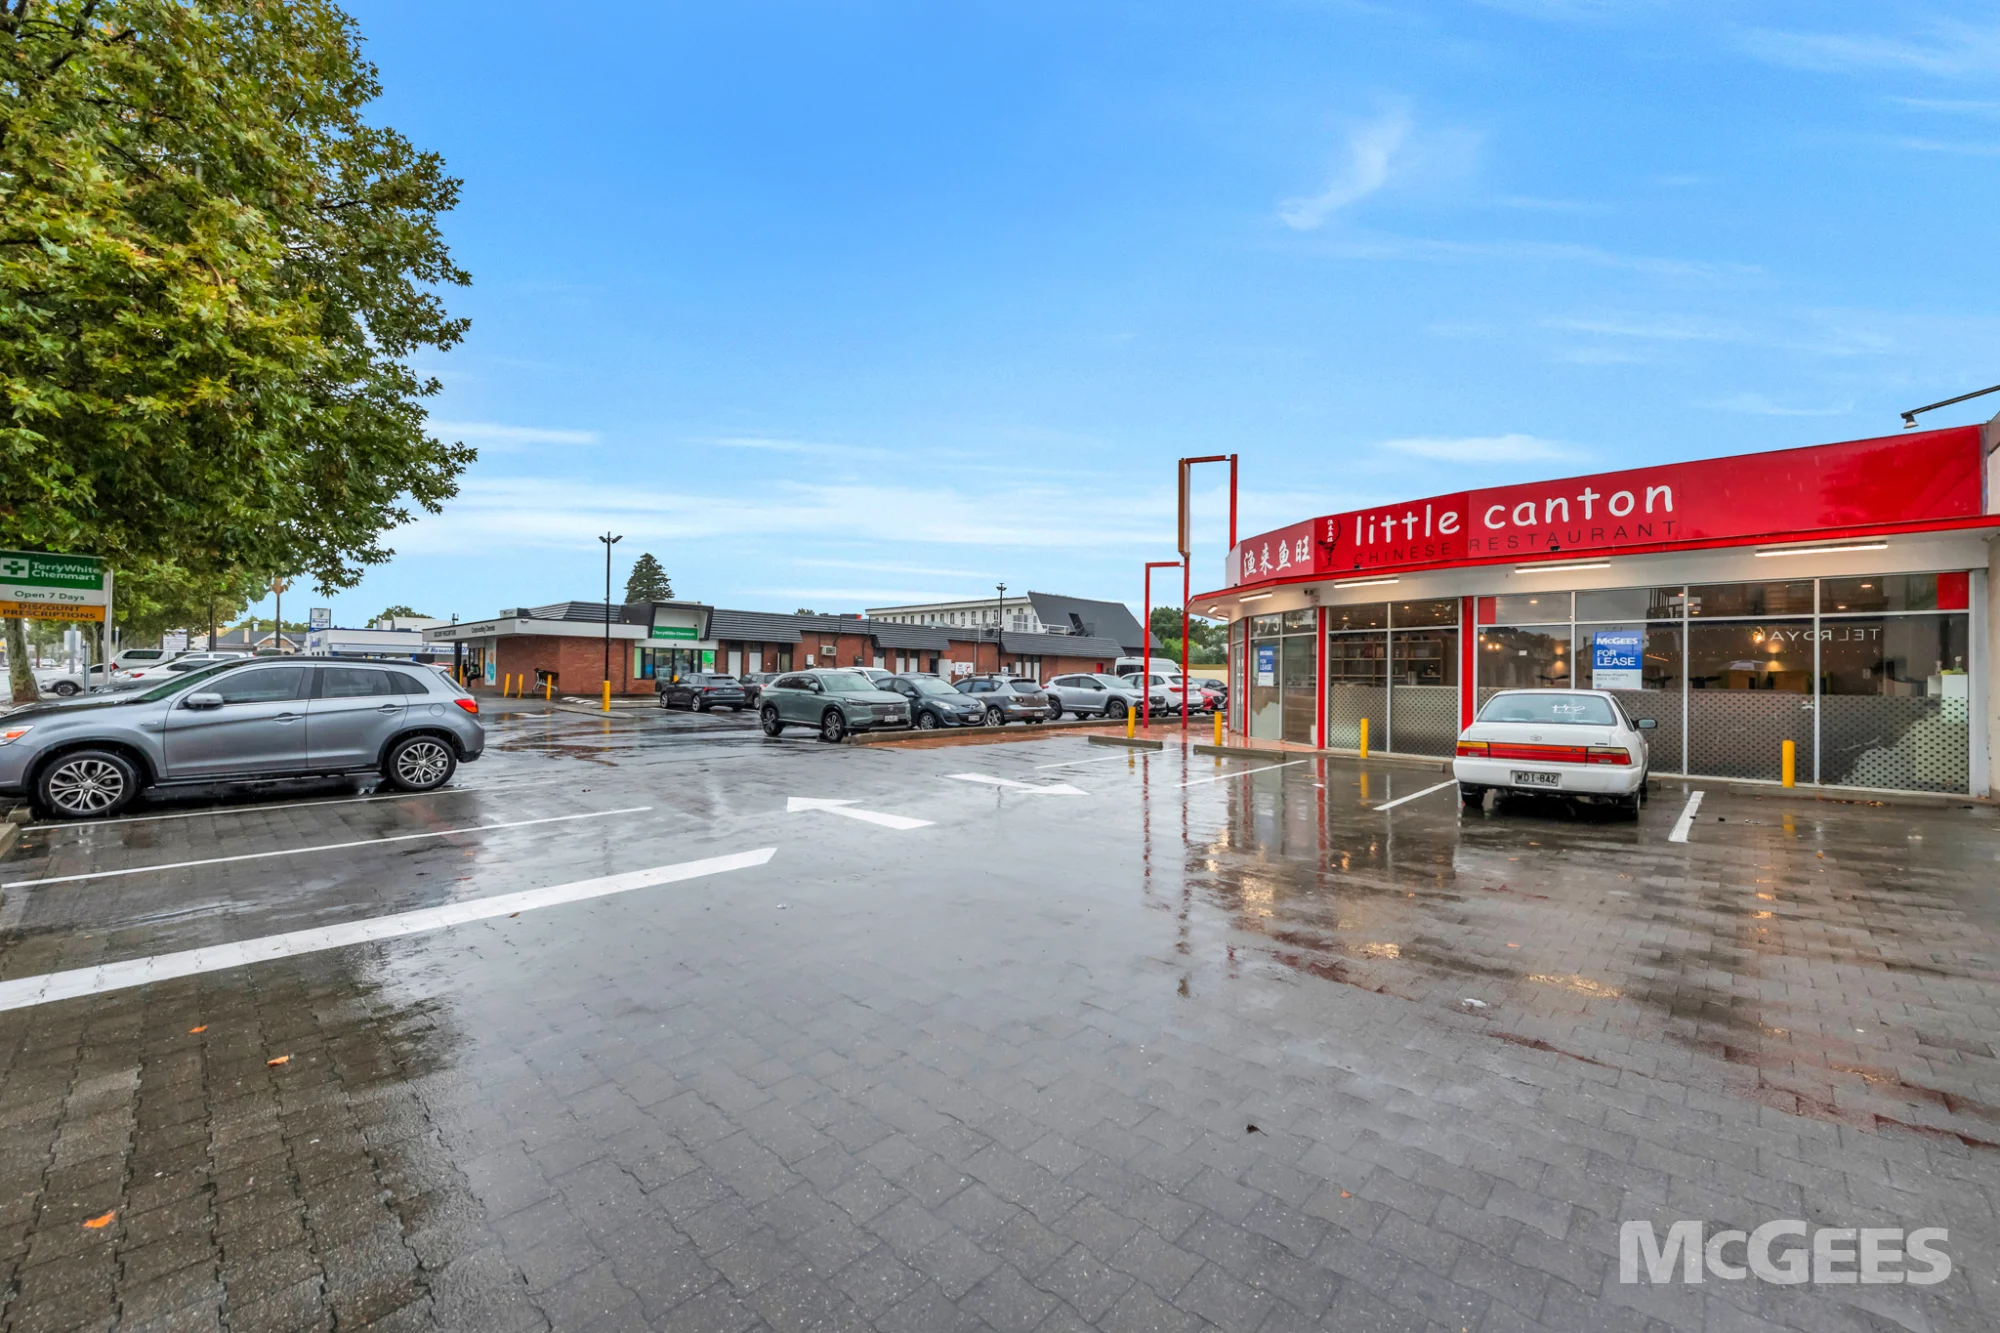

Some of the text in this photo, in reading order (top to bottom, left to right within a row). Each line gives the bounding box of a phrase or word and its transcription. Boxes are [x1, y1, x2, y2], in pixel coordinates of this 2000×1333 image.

[1355, 485, 1673, 546] little canton
[1354, 520, 1677, 565] CHINESE RESTAURANT
[32, 561, 100, 574] TerryWhite
[32, 570, 96, 581] Chemmart
[14, 590, 45, 599] Open
[59, 593, 85, 602] Days
[18, 603, 80, 612] DISCOUNT
[3, 609, 96, 619] PRESCRIPTIONS
[1597, 649, 1617, 657] FOR
[1597, 657, 1636, 666] LEASE
